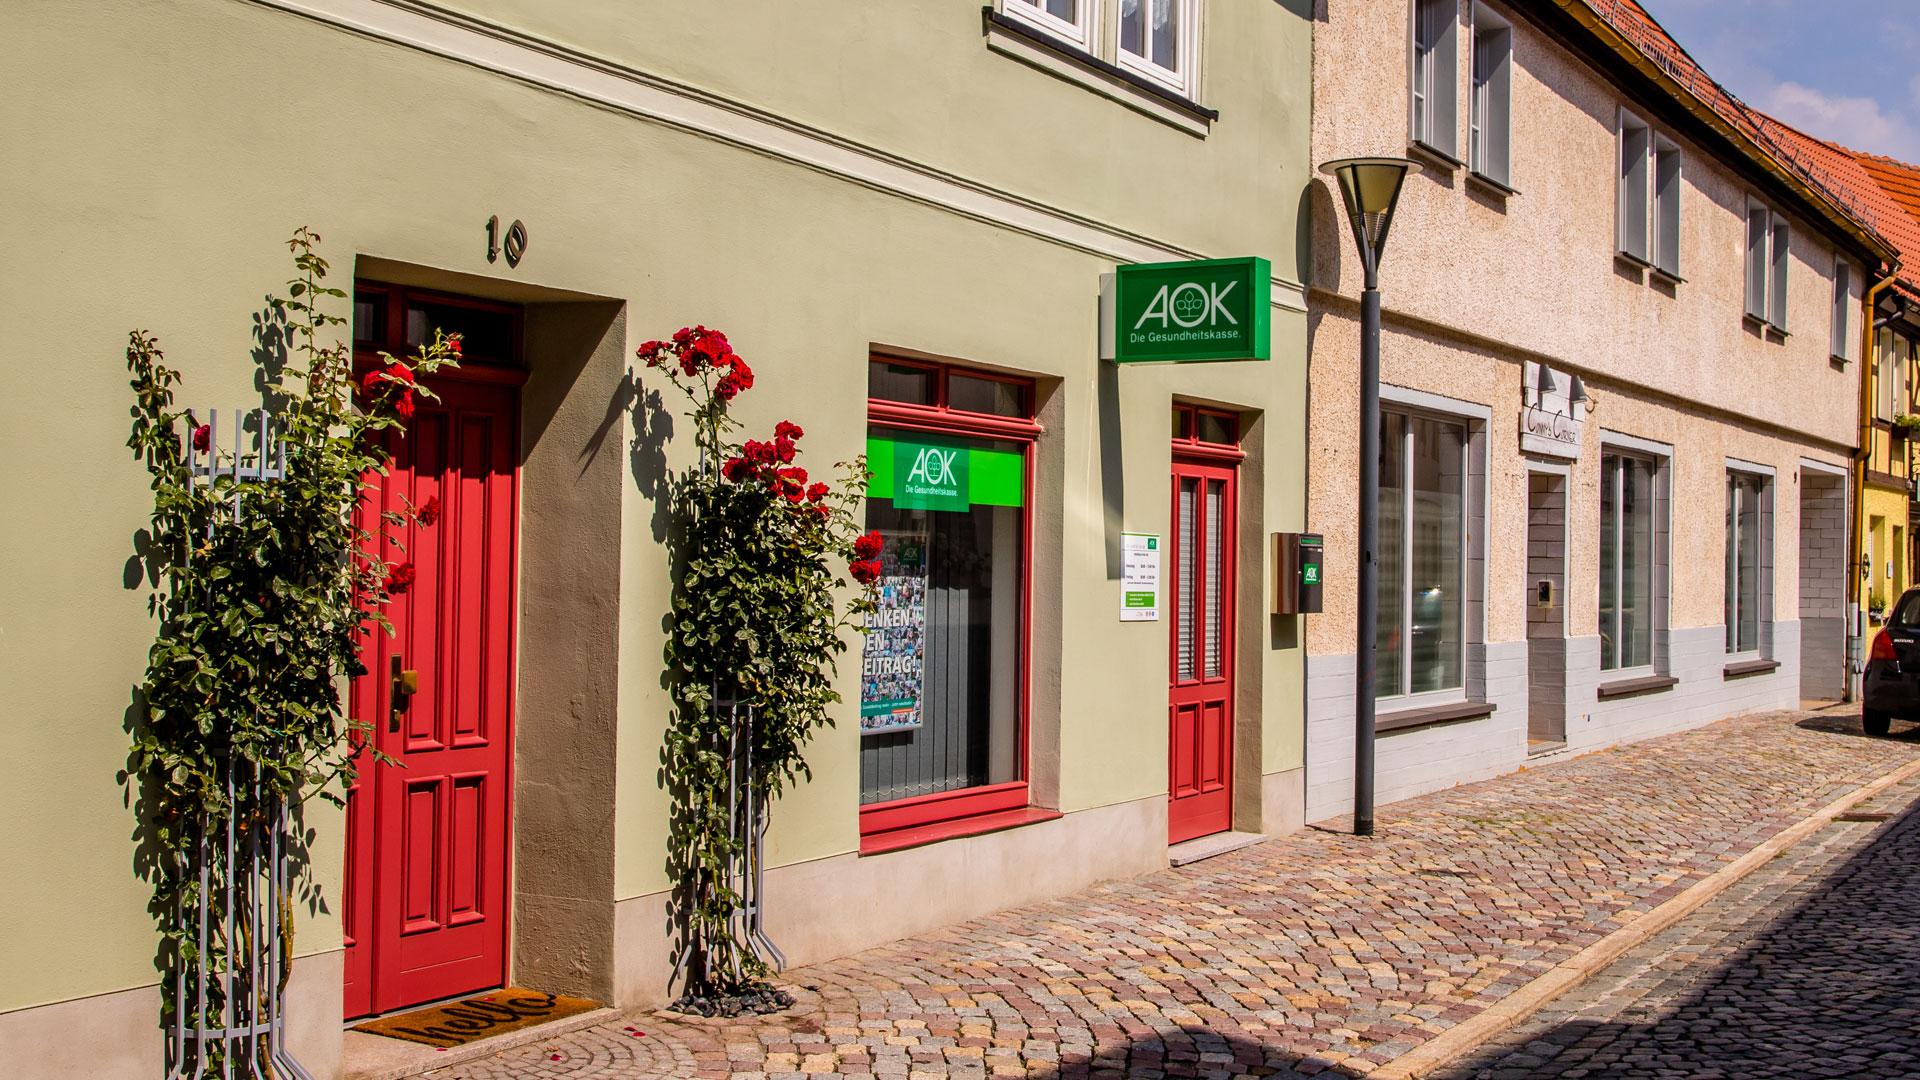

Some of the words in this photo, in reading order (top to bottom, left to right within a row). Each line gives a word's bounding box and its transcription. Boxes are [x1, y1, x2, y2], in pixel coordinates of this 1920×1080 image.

[486, 214, 528, 269] 10
[1134, 280, 1238, 330] AOK
[1130, 332, 1145, 343] Die
[907, 447, 957, 486] AOK
[905, 484, 914, 493] Die
